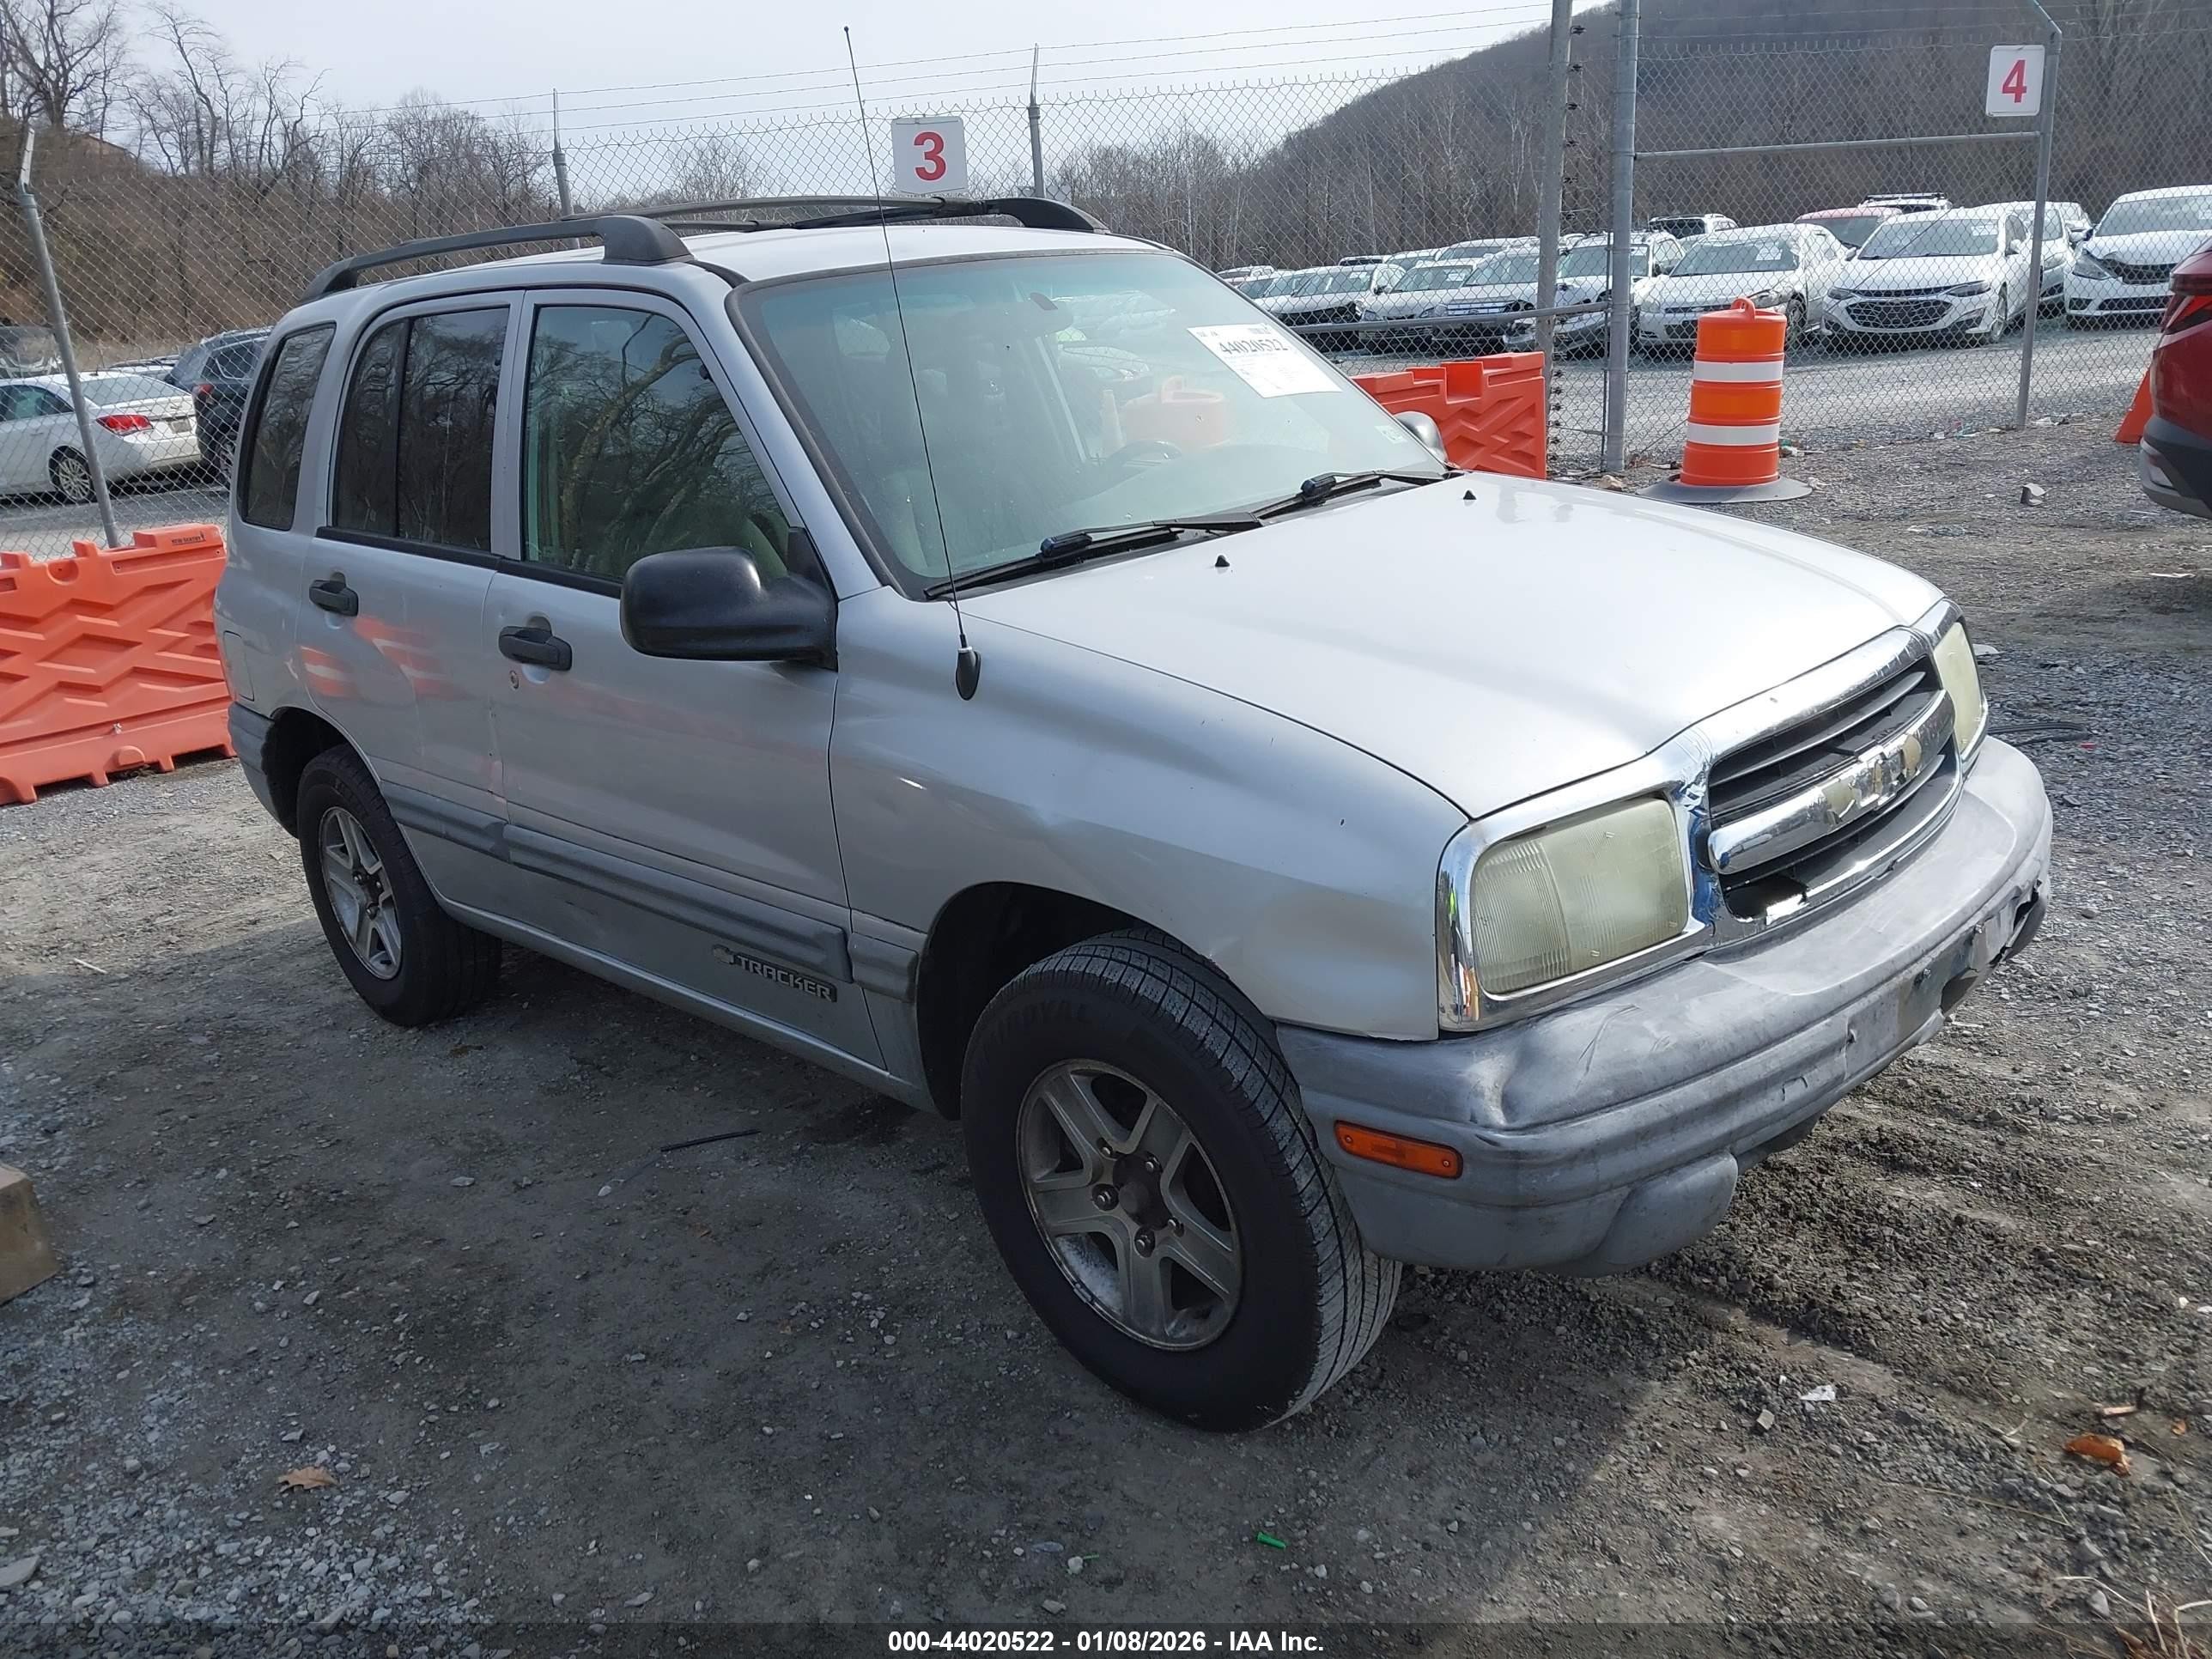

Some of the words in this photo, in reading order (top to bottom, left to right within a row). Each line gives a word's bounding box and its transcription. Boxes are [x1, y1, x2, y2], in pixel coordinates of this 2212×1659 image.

[2002, 59, 2027, 103] 4
[914, 131, 946, 181] 3
[1218, 338, 1289, 355] 44020522
[737, 955, 833, 1002] TRACKER
